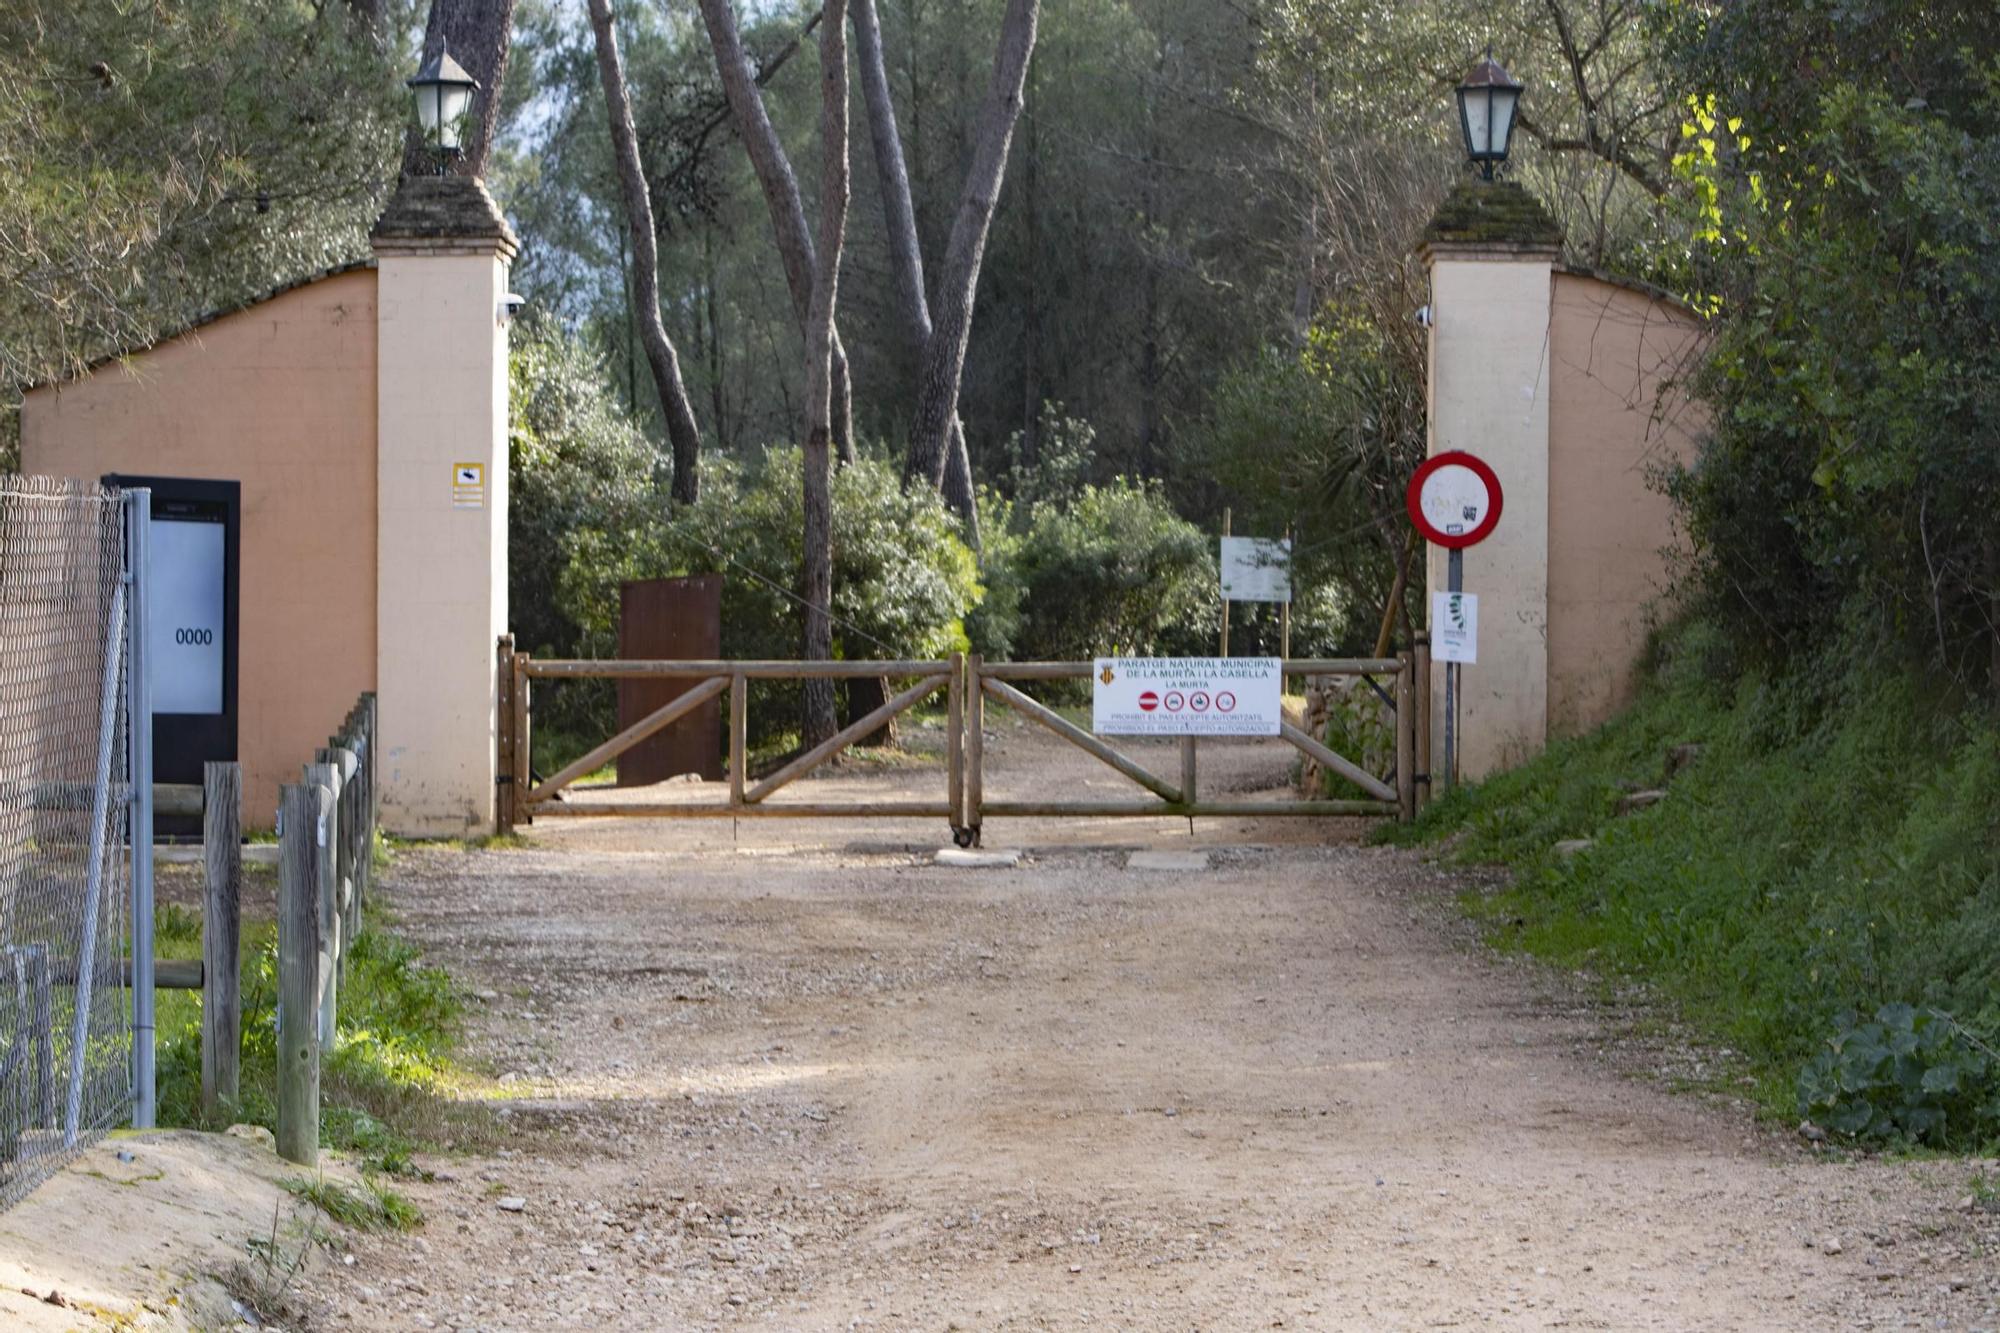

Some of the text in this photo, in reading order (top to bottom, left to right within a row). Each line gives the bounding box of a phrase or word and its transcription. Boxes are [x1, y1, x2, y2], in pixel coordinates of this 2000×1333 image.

[1118, 660, 1277, 669] PARATGE NATURAL MUNICIPAL
[1126, 669, 1140, 679] DE
[1143, 669, 1157, 679] LA
[1159, 669, 1196, 679] MURTA
[1204, 669, 1218, 679] LA
[1220, 669, 1269, 679] CASELLA
[1165, 680, 1210, 689] LA MURTA
